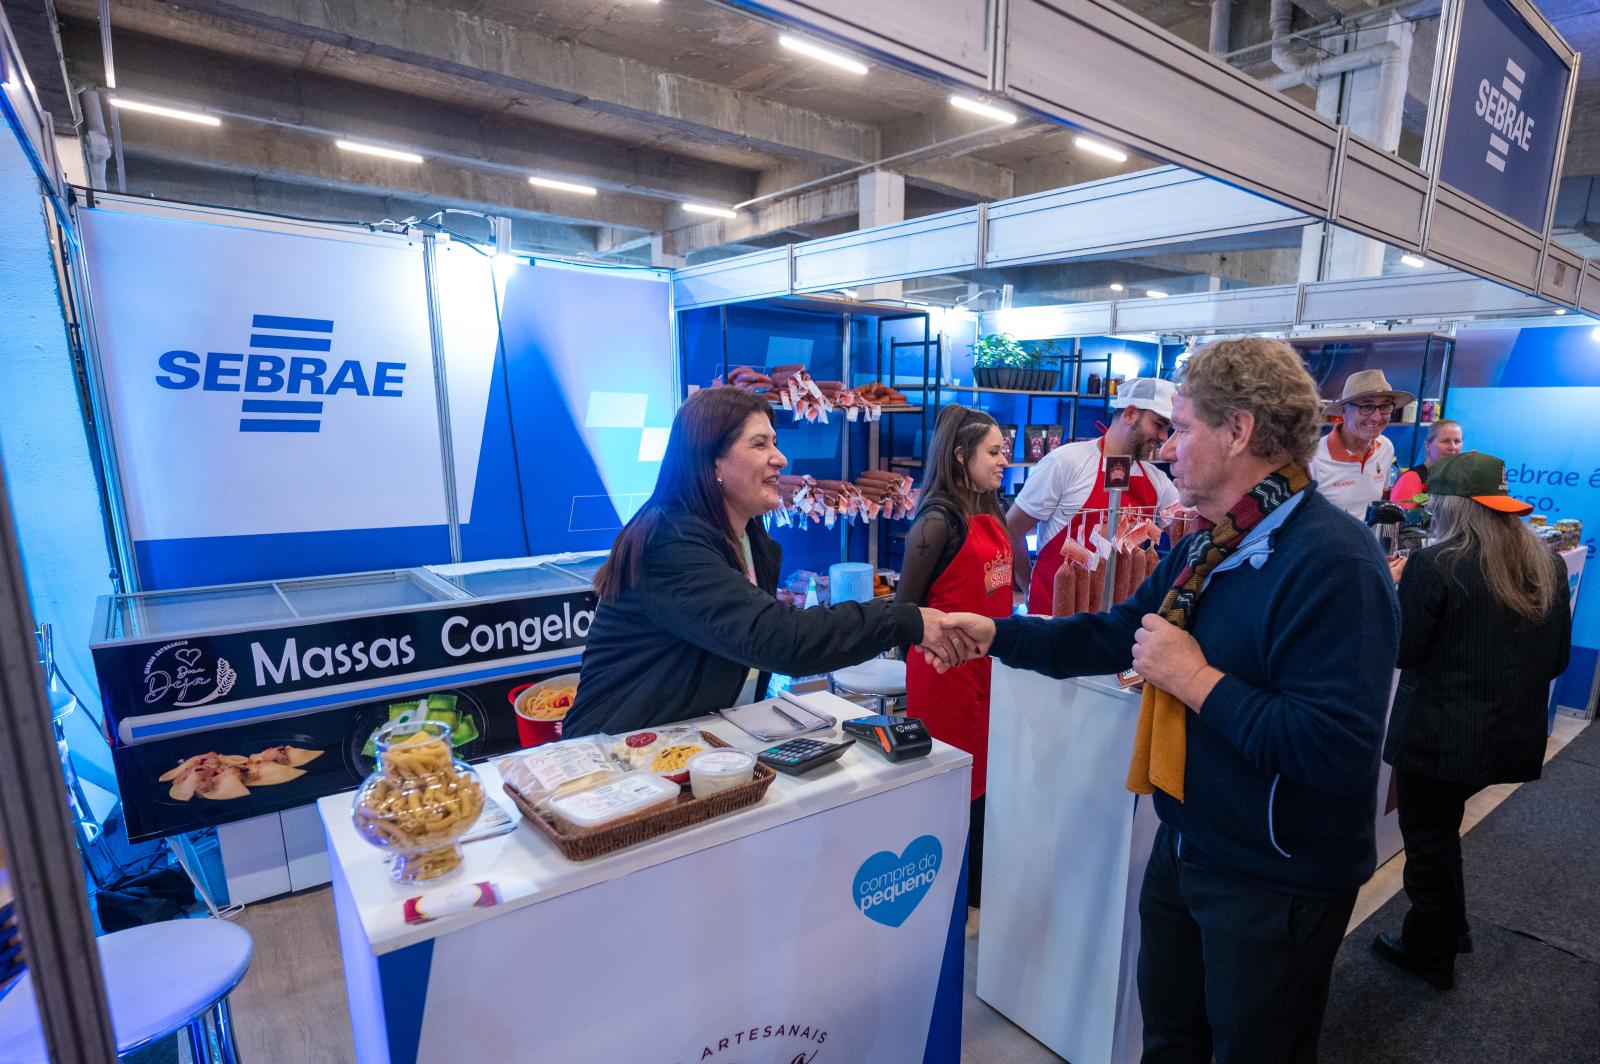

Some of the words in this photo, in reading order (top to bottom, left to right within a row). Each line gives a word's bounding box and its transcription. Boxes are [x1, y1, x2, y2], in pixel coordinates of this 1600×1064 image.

[1475, 78, 1535, 152] SEBRAE
[155, 350, 407, 398] SEBRAE
[1506, 463, 1580, 487] ebrae
[250, 637, 416, 687] Massas
[441, 602, 596, 658] Congela
[860, 862, 916, 895] compre
[918, 852, 937, 871] do
[861, 868, 936, 915] pequeno
[701, 1024, 828, 1061] ARTESANAIS
